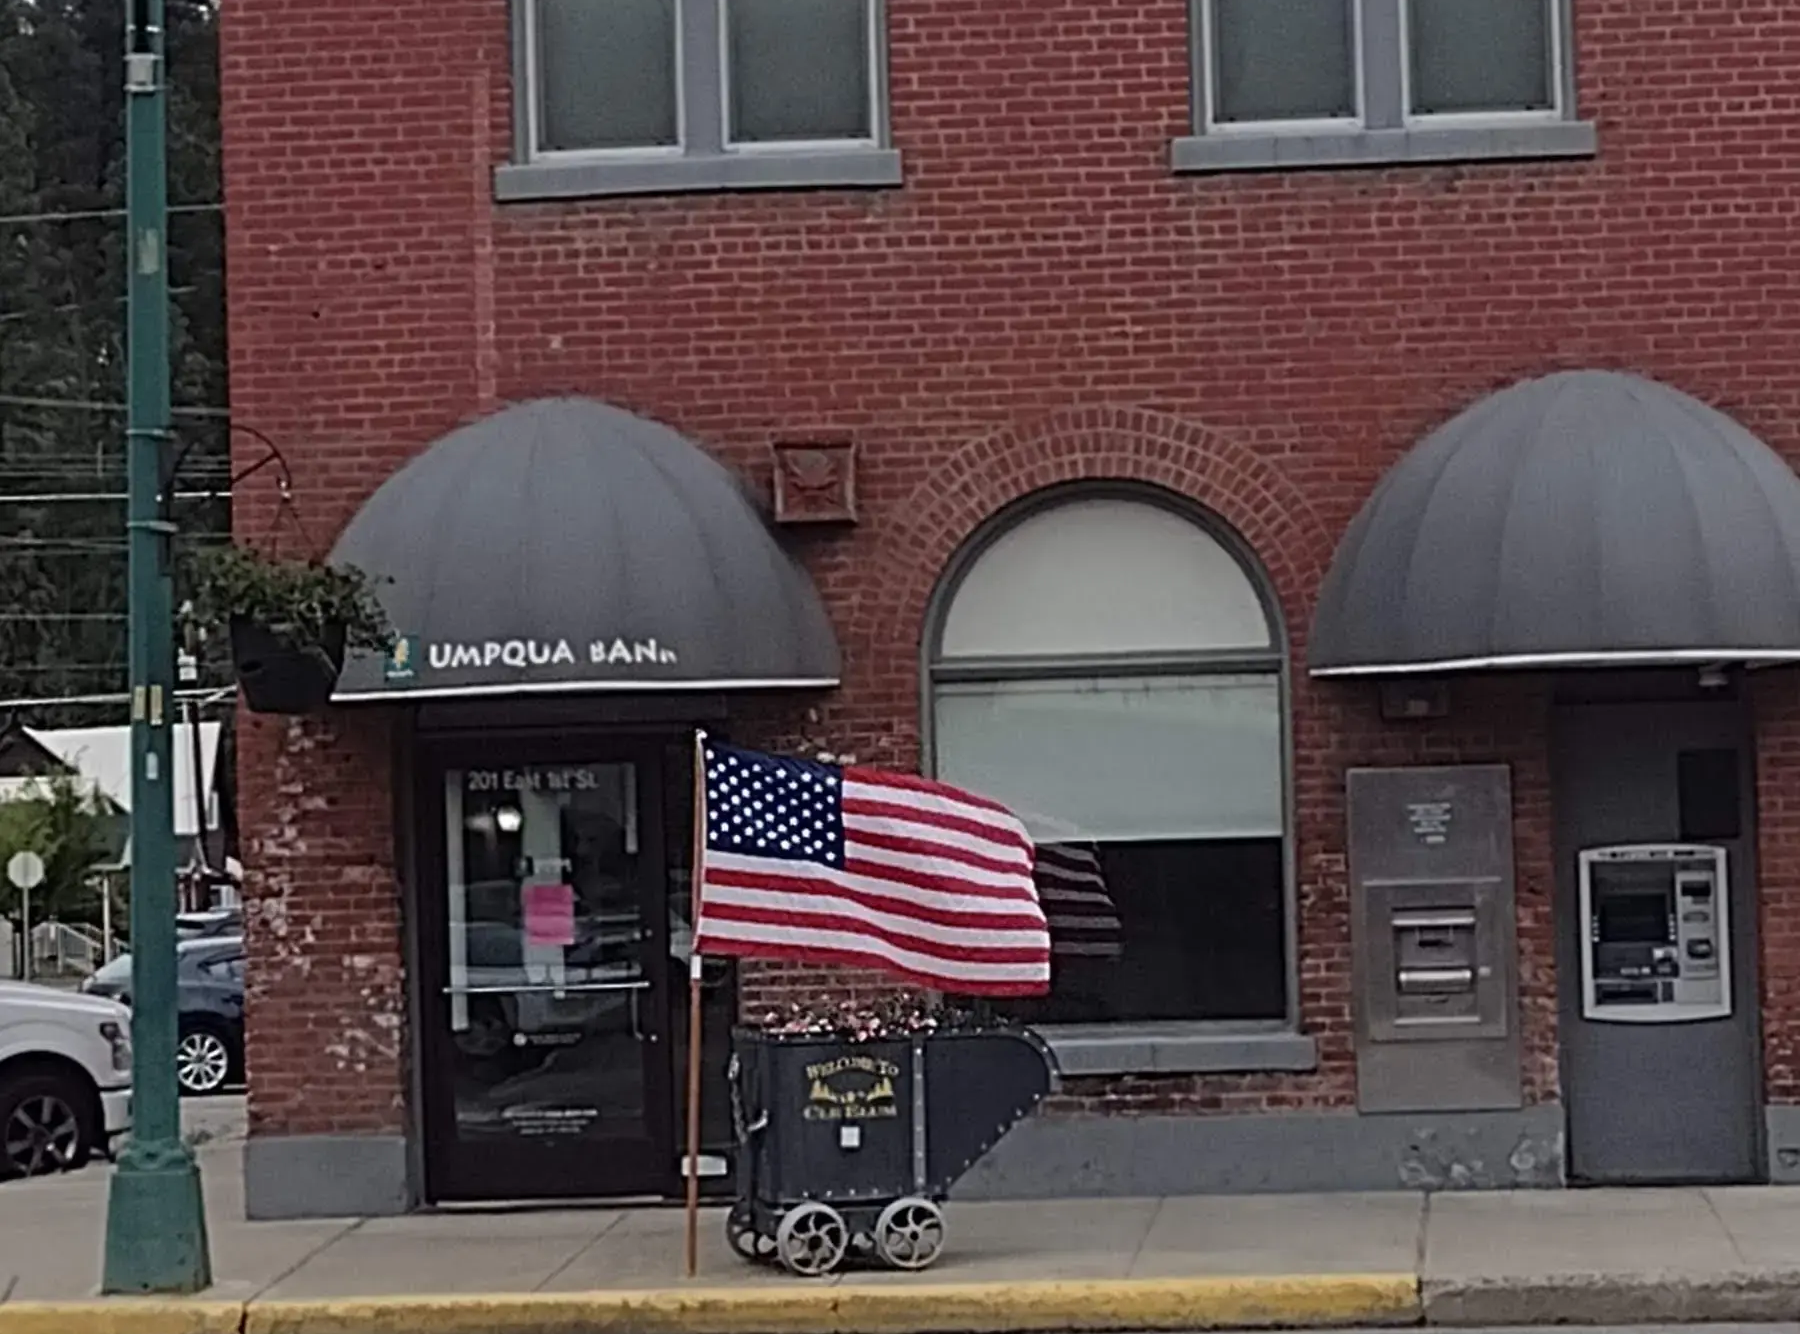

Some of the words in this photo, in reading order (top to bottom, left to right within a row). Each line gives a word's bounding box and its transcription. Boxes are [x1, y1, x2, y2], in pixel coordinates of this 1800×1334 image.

[428, 638, 575, 668] UMPQUA
[467, 770, 499, 790] 201
[502, 770, 541, 790] East
